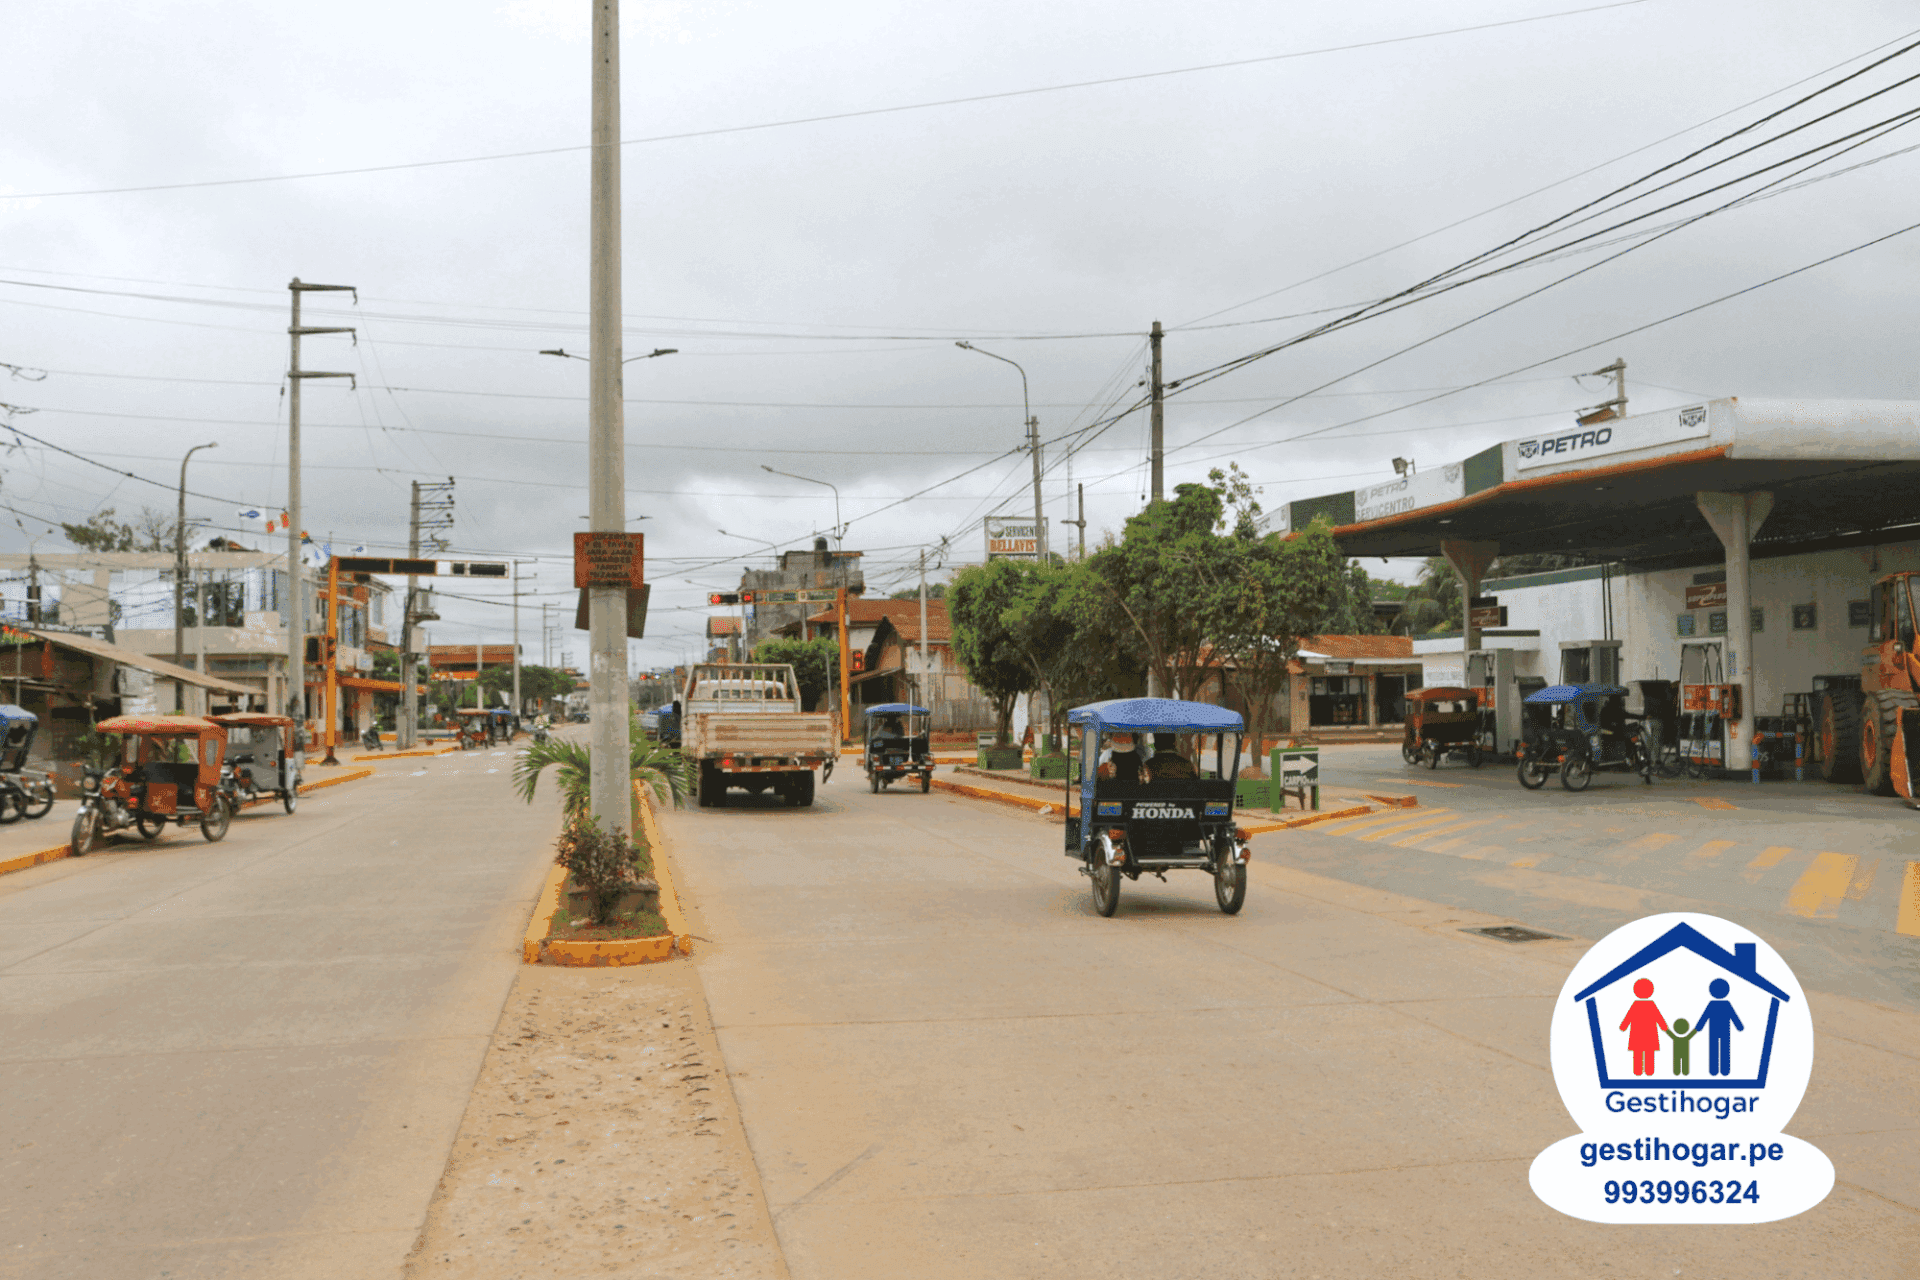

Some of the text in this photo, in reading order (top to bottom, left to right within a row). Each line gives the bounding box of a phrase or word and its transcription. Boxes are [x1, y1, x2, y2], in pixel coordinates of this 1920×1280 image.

[1541, 427, 1613, 456] PETRO
[1370, 479, 1409, 499] PETRO
[1356, 496, 1415, 520] SERVICENTRO
[1131, 807, 1195, 819] HONDA
